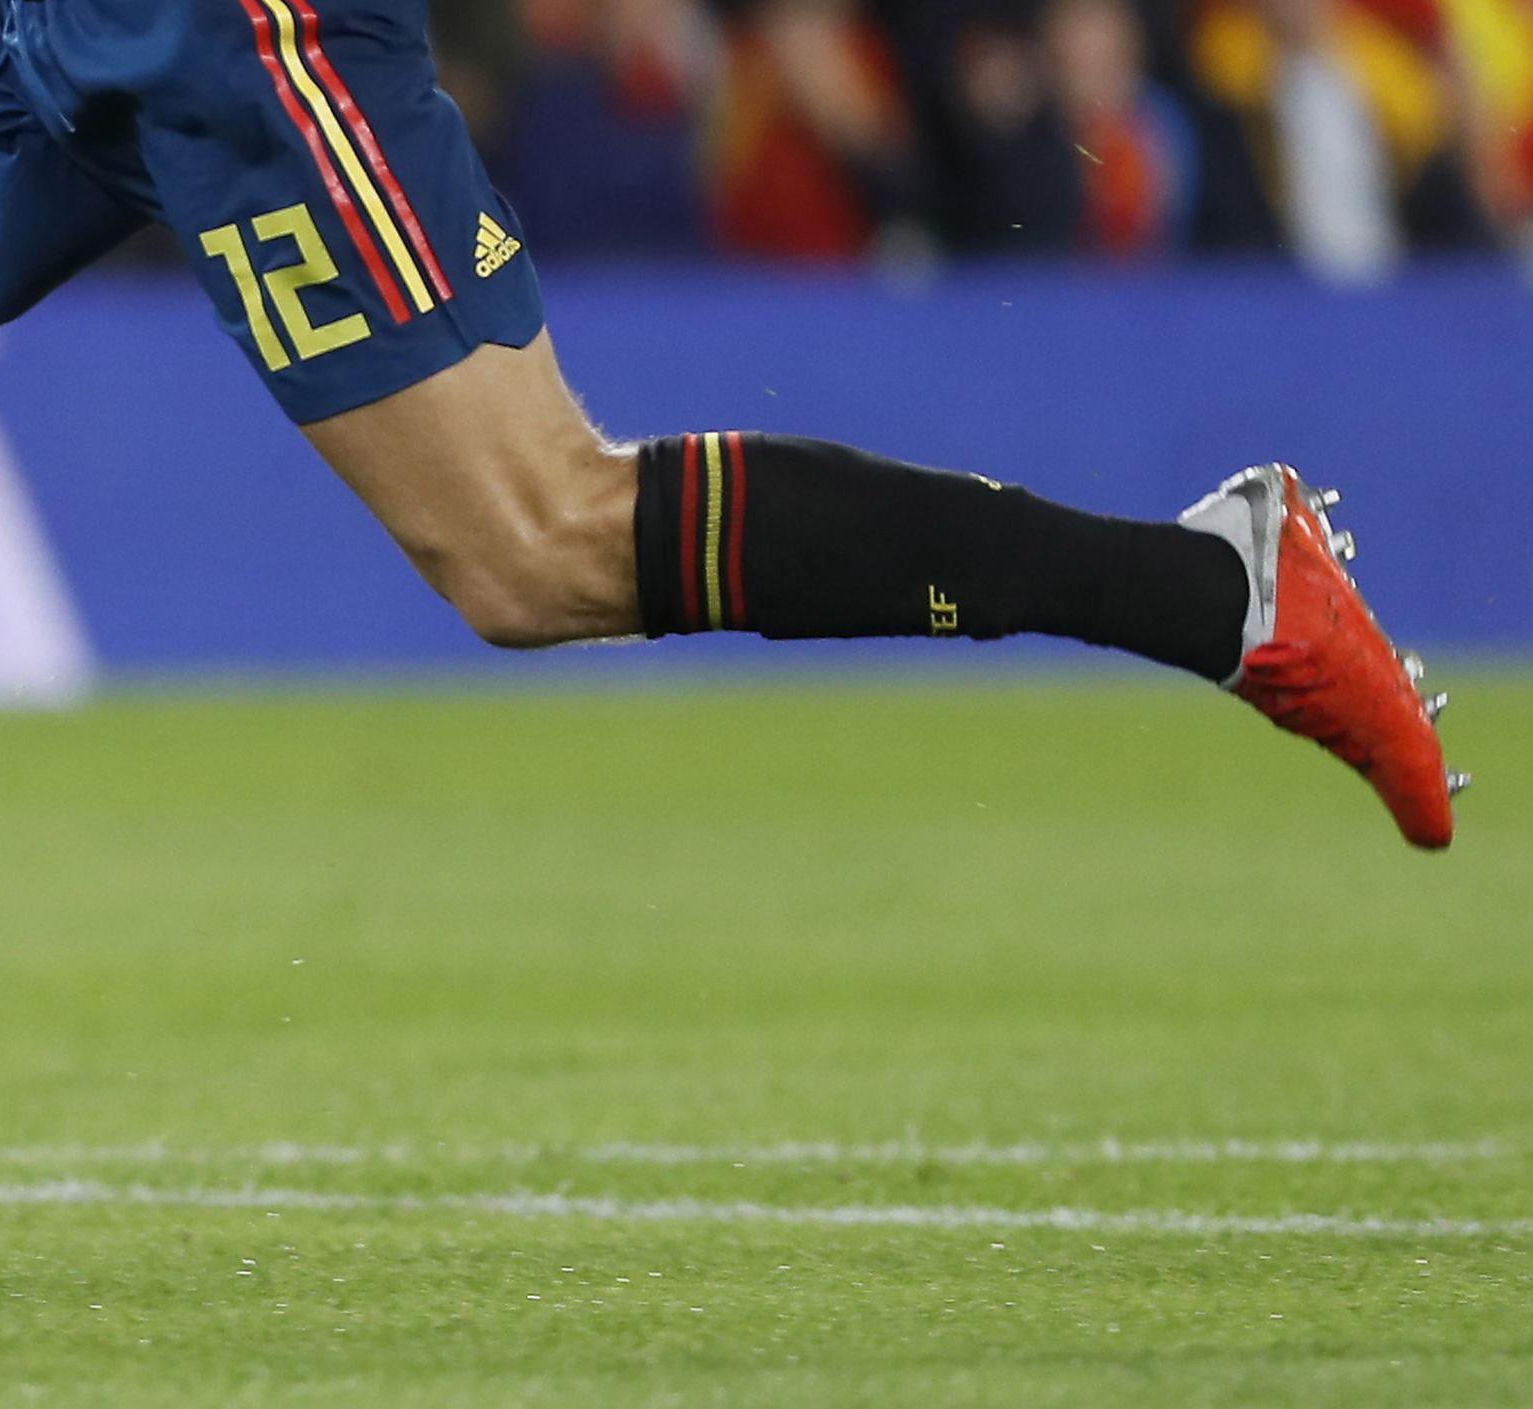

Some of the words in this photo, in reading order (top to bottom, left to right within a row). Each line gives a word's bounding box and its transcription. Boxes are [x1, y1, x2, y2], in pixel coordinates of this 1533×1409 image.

[474, 236, 522, 279] adidas
[199, 203, 373, 372] 12
[929, 585, 958, 633] EF
